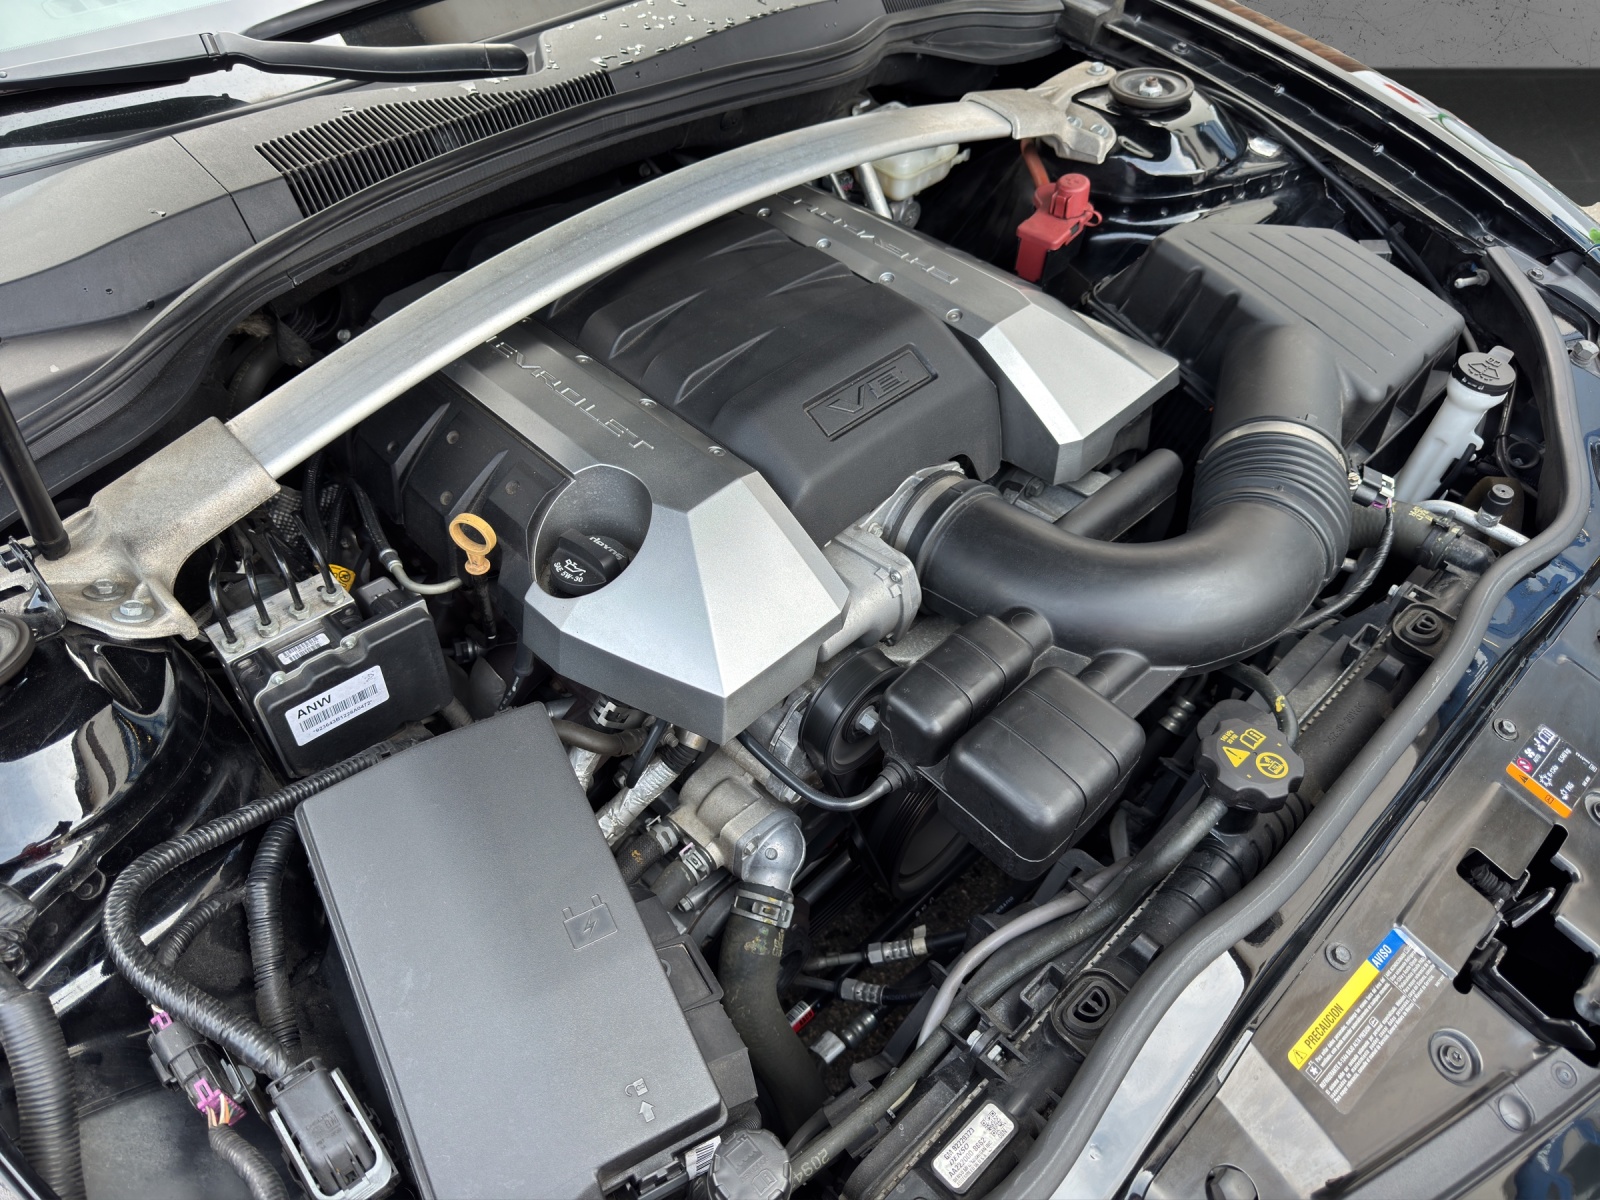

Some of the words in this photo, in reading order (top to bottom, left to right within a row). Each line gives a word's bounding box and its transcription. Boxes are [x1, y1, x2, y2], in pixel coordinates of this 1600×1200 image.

[486, 336, 655, 448] EVROLET
[825, 365, 909, 414] V8
[553, 562, 563, 572] SAE
[560, 570, 583, 582] 5W-30
[297, 694, 331, 719] ANW
[1370, 943, 1392, 968] AVISO
[1303, 1002, 1344, 1049] PRECAUCION
[1318, 1063, 1340, 1089] REFRIGERANTE
[1345, 1045, 1355, 1055] BAJO
[1351, 1037, 1361, 1047] ALTA
[943, 1149, 953, 1160] GM
[947, 1142, 970, 1166] DENSO
